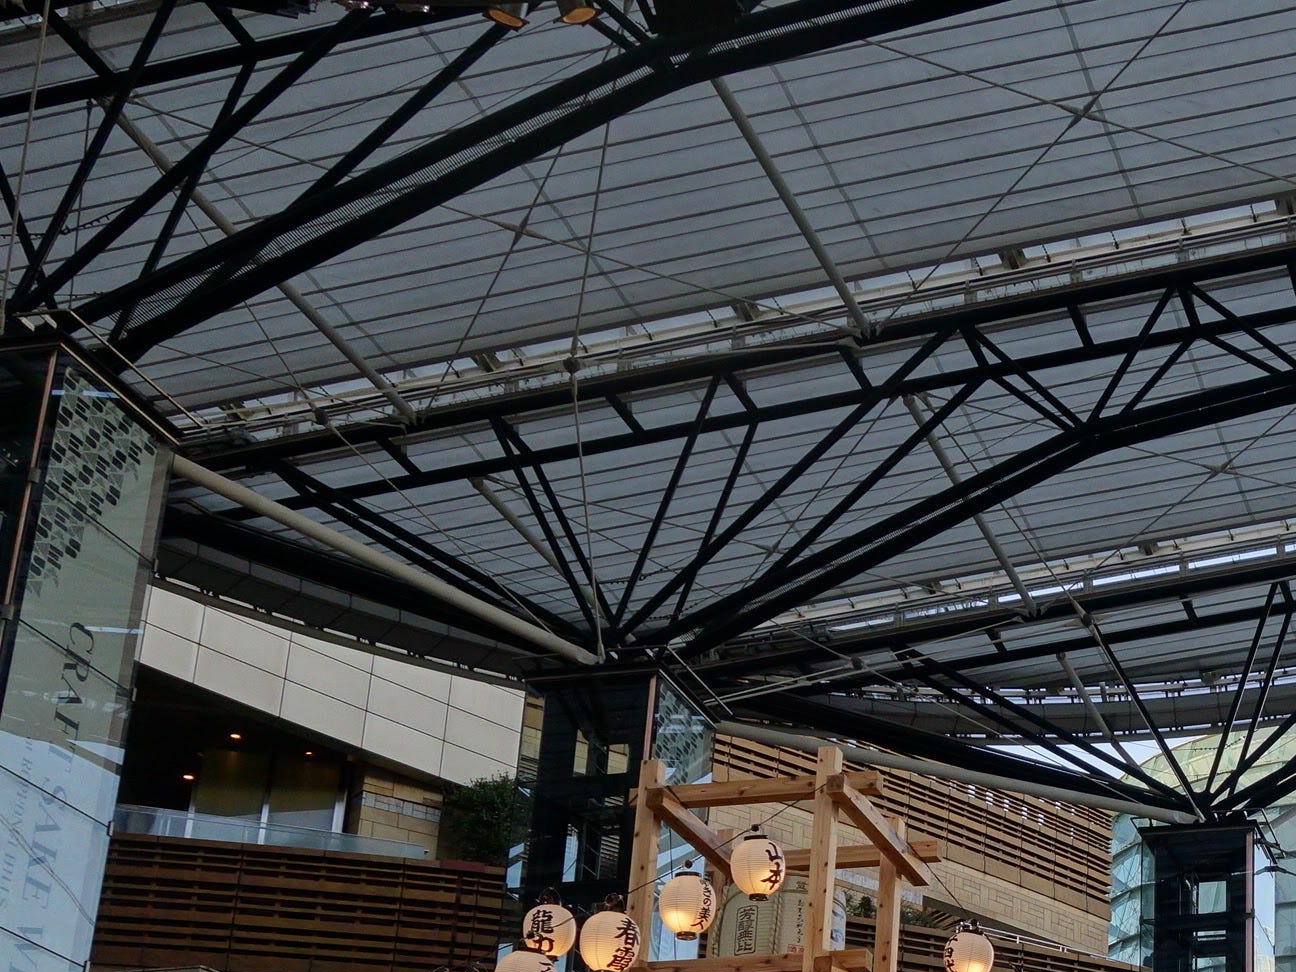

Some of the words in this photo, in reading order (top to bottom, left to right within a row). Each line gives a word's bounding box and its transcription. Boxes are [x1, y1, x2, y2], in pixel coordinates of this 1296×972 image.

[22, 777, 68, 910] SAKE
[761, 841, 784, 891] 山本
[530, 909, 555, 955] 龍力
[607, 917, 640, 972] 春霞
